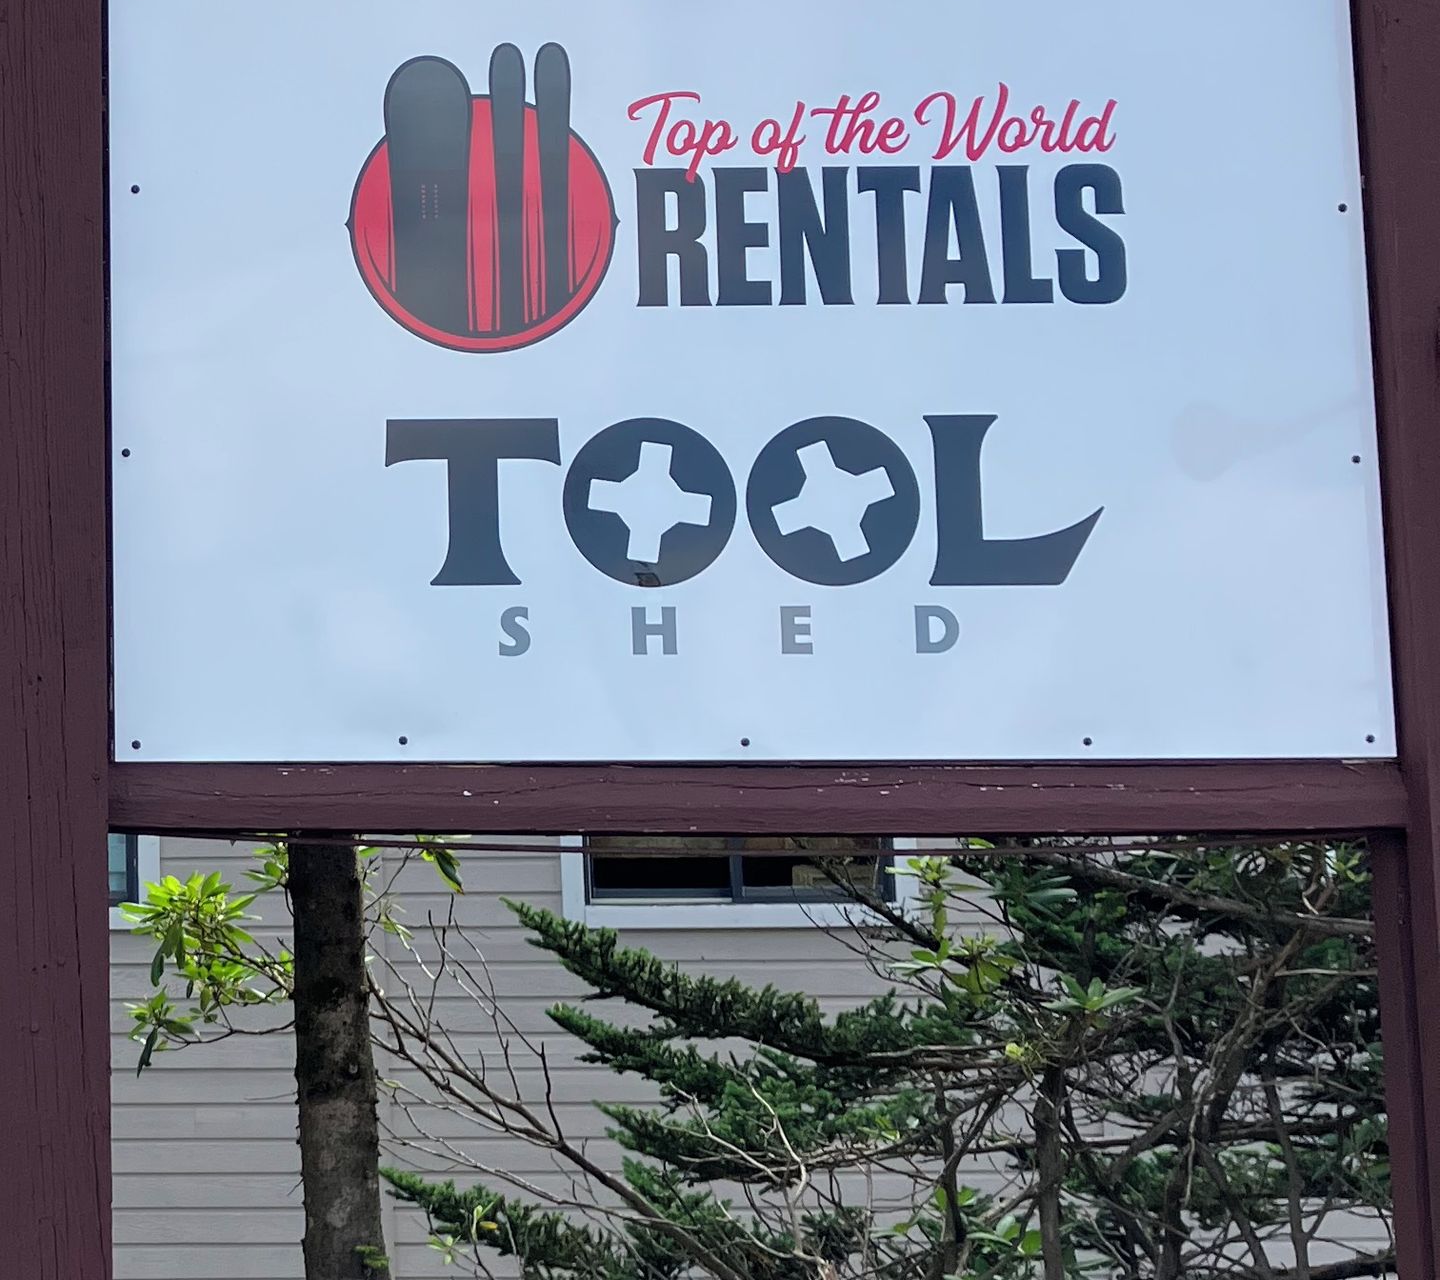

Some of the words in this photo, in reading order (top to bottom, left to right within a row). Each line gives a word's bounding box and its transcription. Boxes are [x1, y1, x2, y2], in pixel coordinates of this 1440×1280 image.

[627, 91, 738, 184] Top
[751, 101, 807, 175] of
[810, 91, 910, 155] the
[914, 81, 1118, 162] World
[633, 163, 1127, 308] RENTALS
[385, 415, 1104, 587] TOOL
[498, 604, 959, 657] SHED
